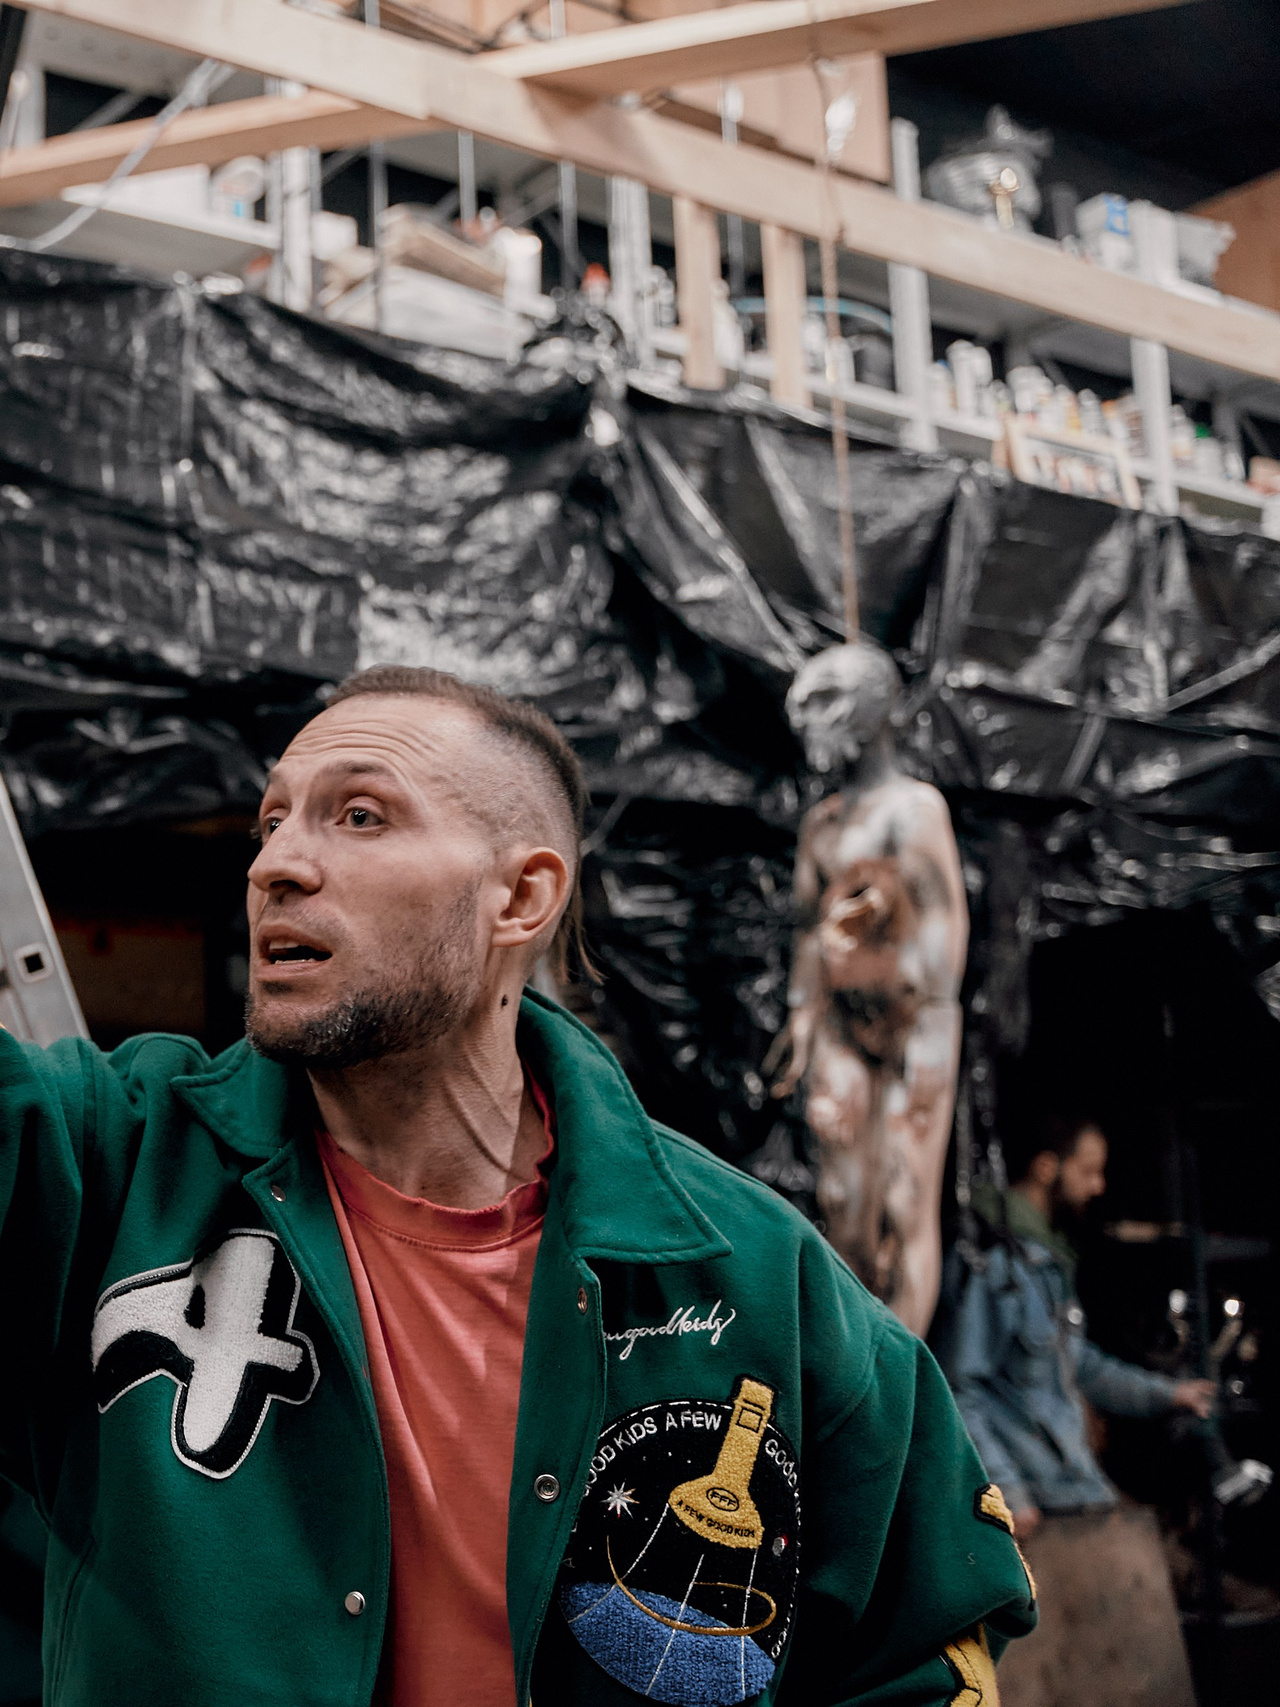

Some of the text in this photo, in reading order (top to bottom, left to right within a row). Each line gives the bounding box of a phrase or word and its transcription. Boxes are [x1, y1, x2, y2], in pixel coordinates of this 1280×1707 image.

[91, 1228, 320, 1479] 4
[613, 1416, 658, 1451] KIDS
[665, 1411, 678, 1432] A
[680, 1409, 722, 1431] FEW
[764, 1438, 798, 1488] GOOD
[683, 1504, 705, 1523] FEW
[706, 1517, 734, 1535] GOOD
[734, 1527, 755, 1538] KIDS
